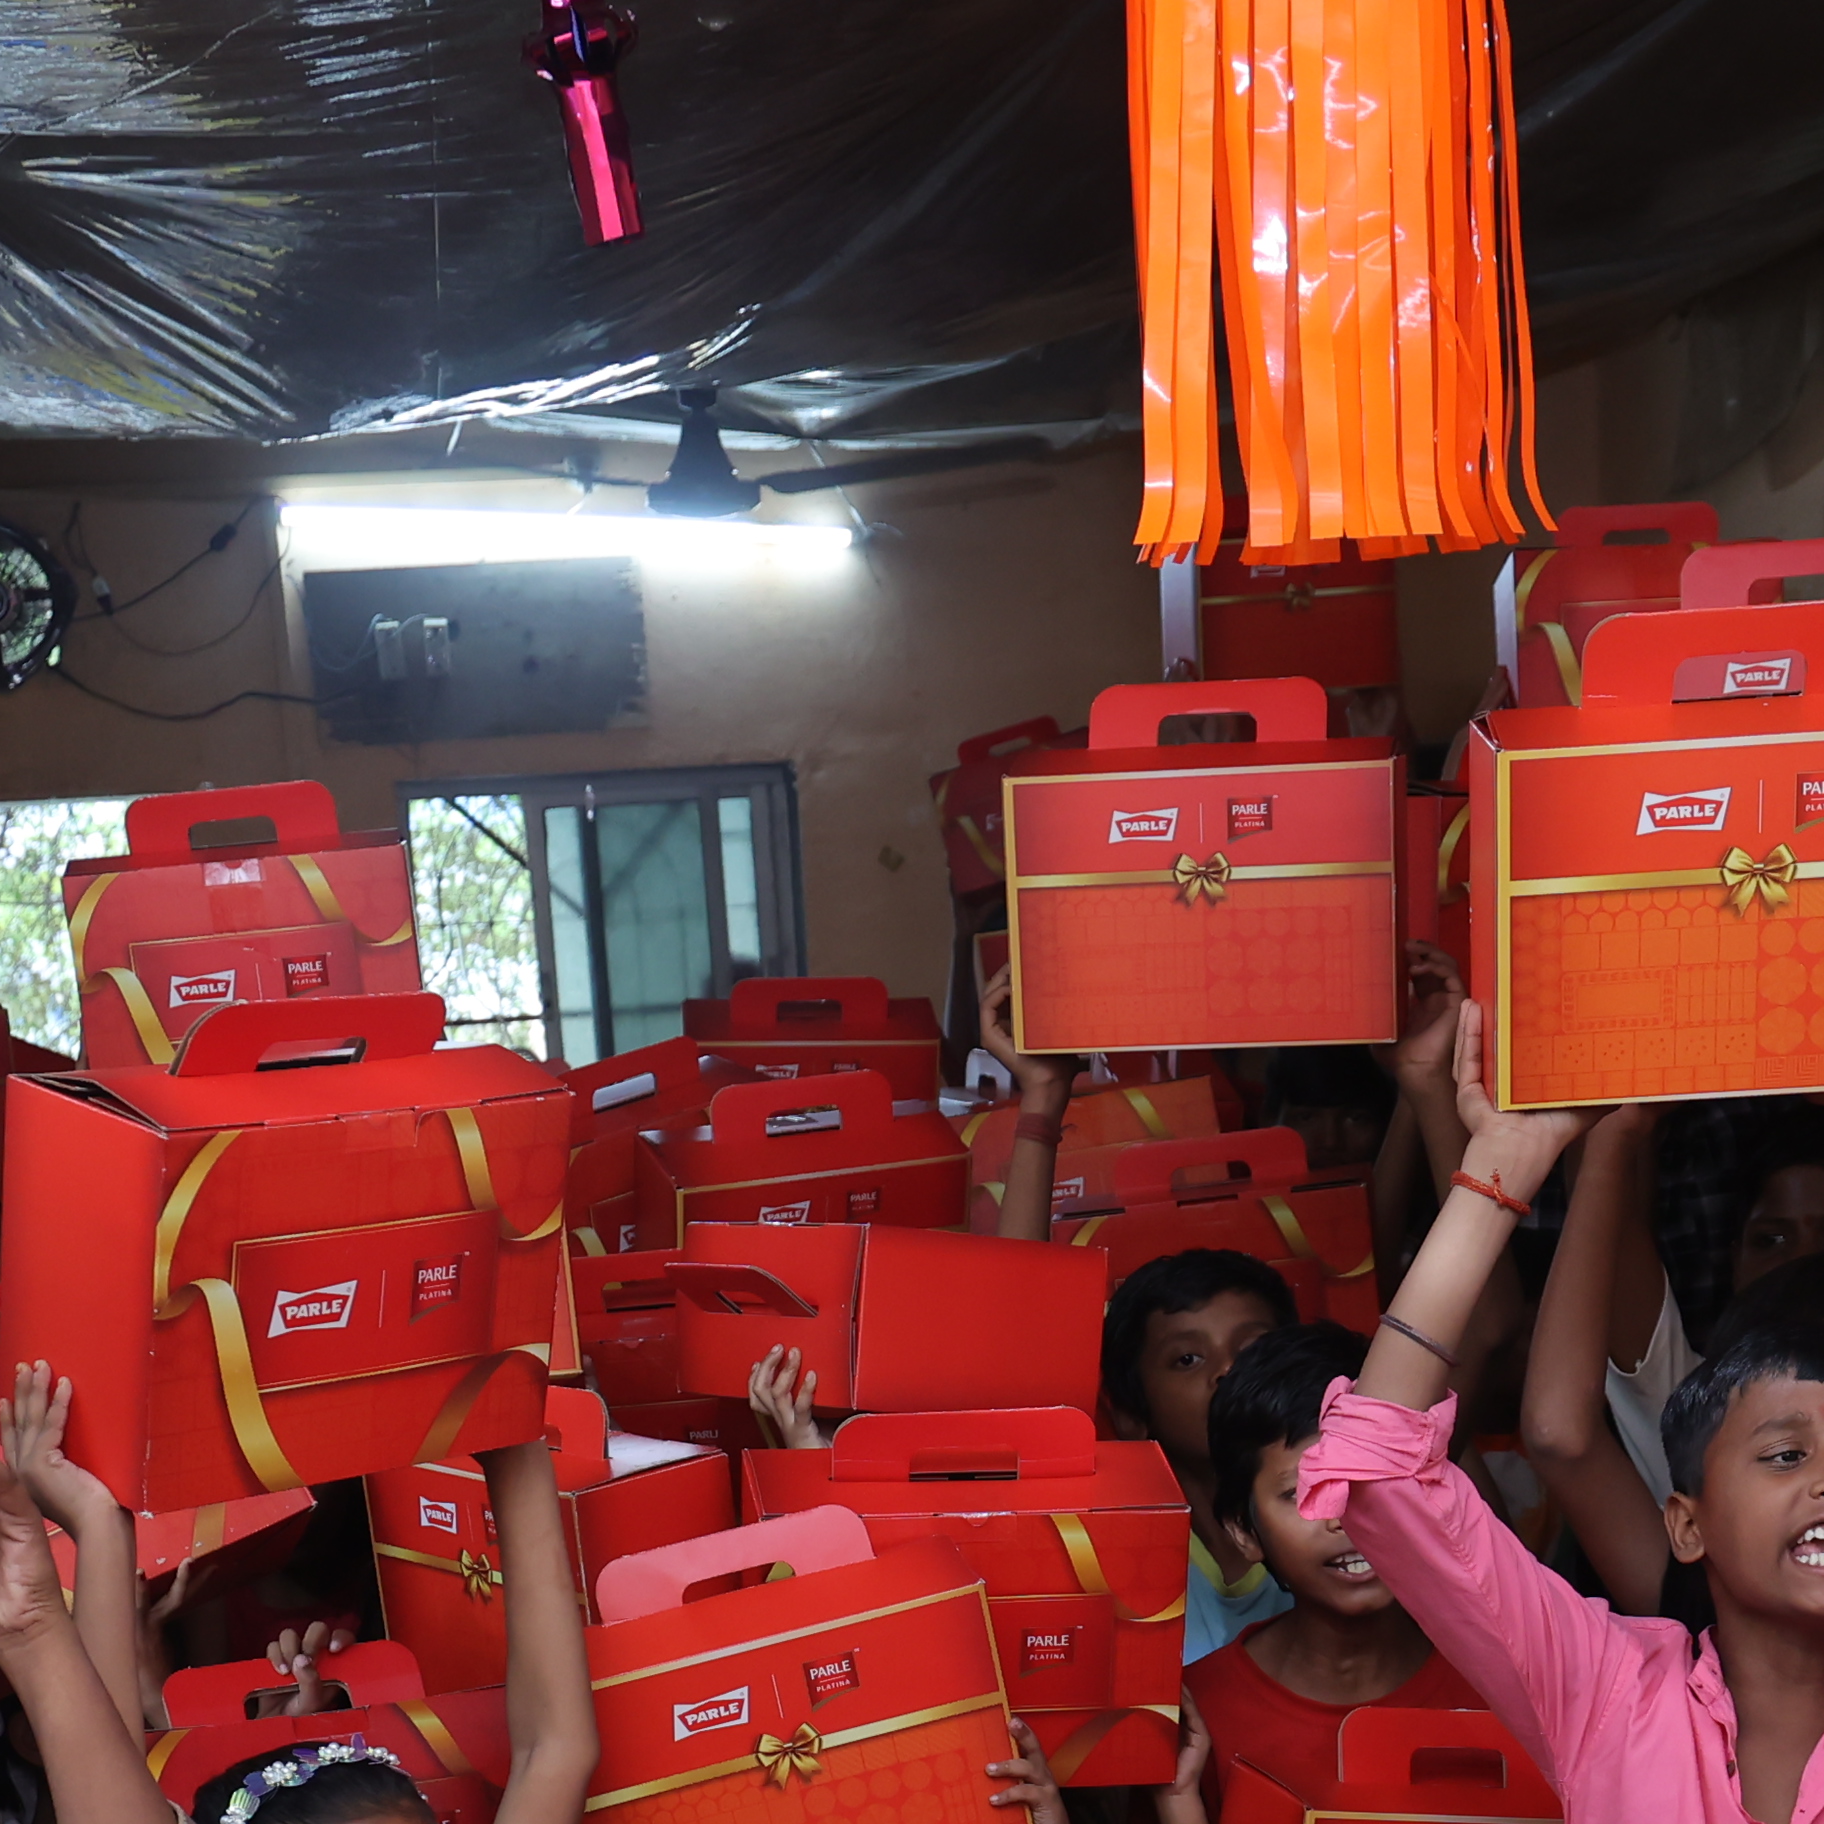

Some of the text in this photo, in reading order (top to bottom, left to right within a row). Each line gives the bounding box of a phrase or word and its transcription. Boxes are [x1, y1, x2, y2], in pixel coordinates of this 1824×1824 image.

[1735, 670, 1781, 683] PARLE
[1232, 803, 1268, 816] PARLE
[1653, 803, 1717, 820] PARLE
[1121, 820, 1168, 833] PARLE
[1235, 820, 1265, 828] PLATINA
[288, 960, 323, 974] PARLE
[292, 977, 322, 986] PLATINA
[180, 982, 226, 997] PARLE
[850, 1191, 876, 1202] PARLE
[417, 1264, 457, 1284] PARLE
[419, 1288, 452, 1300] PLATINA
[285, 1299, 343, 1320] PARLE
[425, 1509, 452, 1523] PARLE
[1027, 1634, 1069, 1647] PARLE
[1029, 1653, 1065, 1661] PLATINA
[809, 1659, 851, 1680] PARLE
[816, 1679, 851, 1693] PLATINA
[685, 1701, 740, 1725] PARLE
